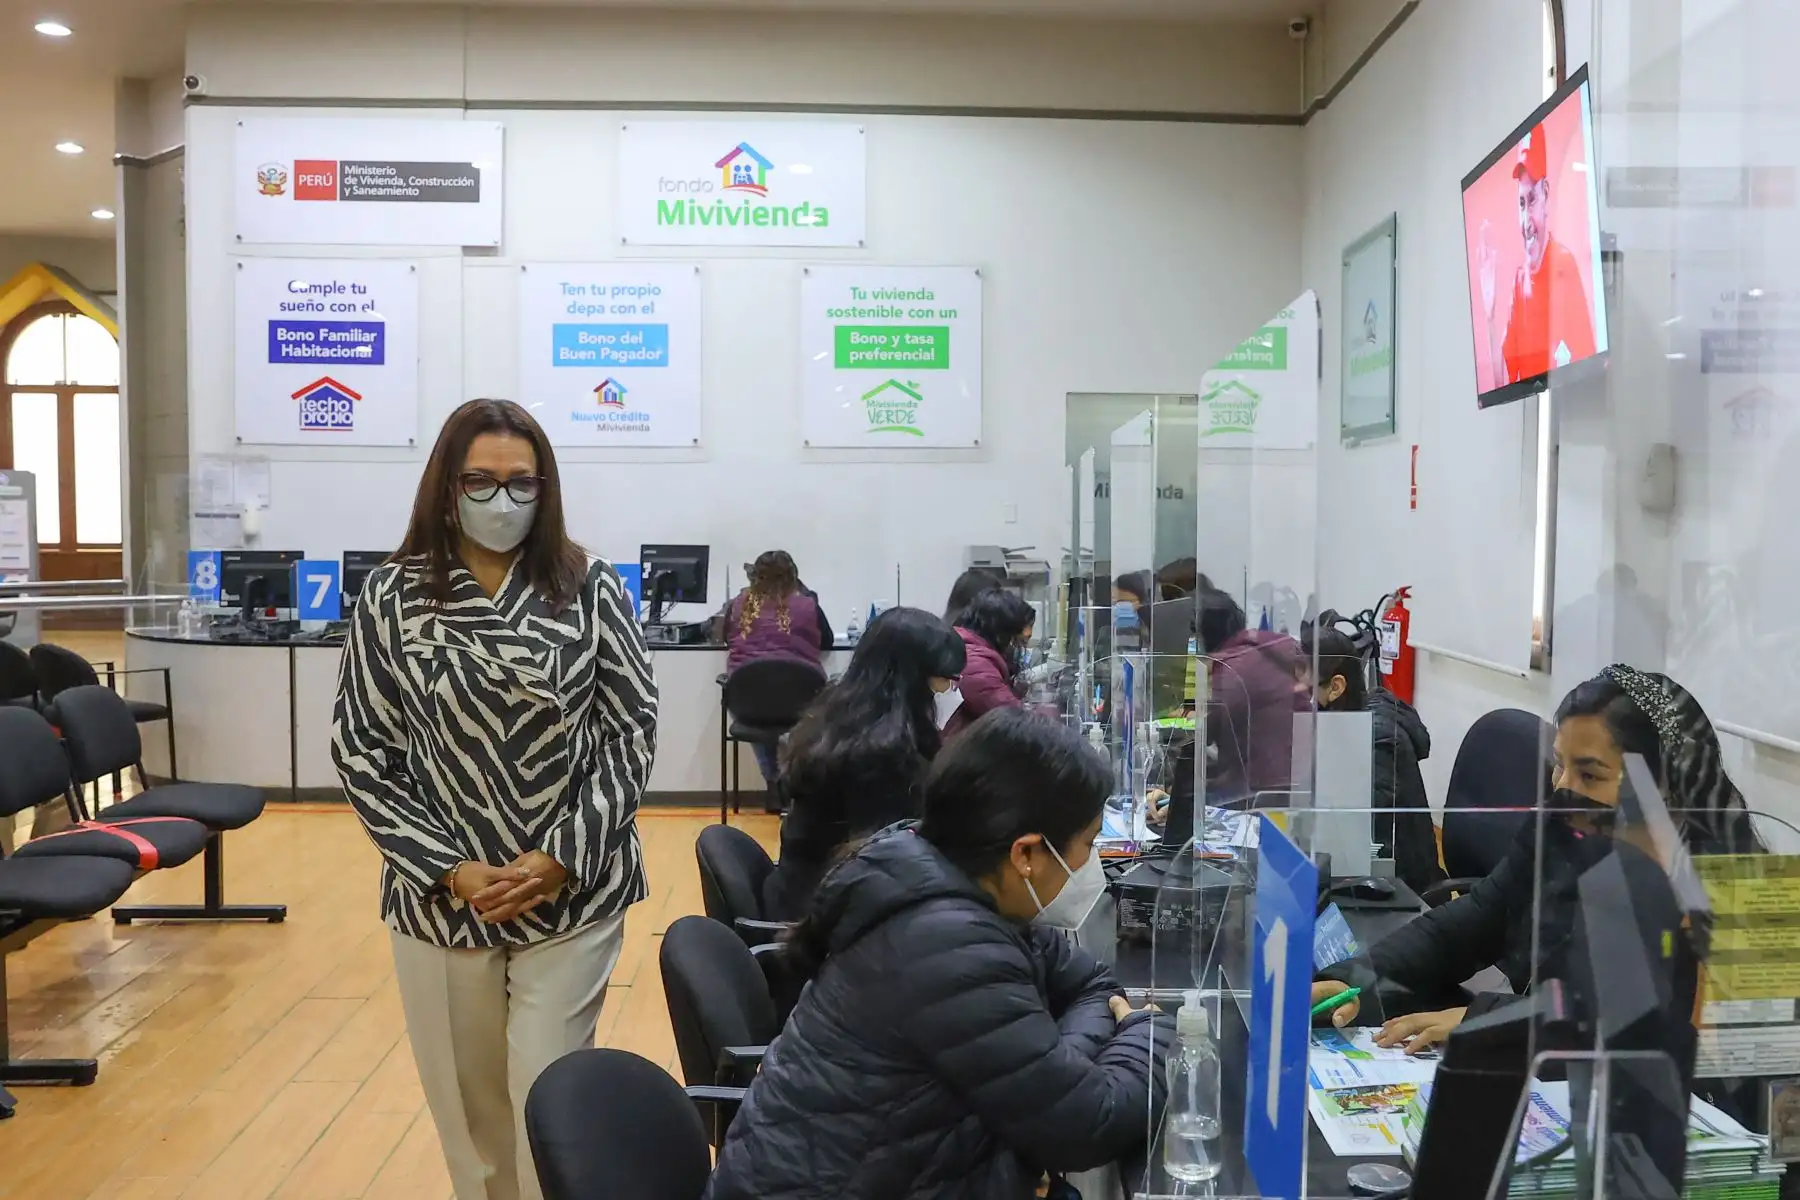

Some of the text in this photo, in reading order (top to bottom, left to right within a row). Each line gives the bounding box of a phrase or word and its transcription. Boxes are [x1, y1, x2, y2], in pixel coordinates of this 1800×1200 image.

[344, 165, 396, 175] Ministerio
[298, 172, 333, 187] PERÚ
[344, 176, 475, 187] de Vivienda, Construcción
[658, 176, 714, 193] fondo
[344, 186, 420, 196] y Saneamiento
[657, 199, 829, 227] Mivivienda
[351, 282, 367, 294] tu
[559, 282, 662, 299] Ten tu propio
[850, 286, 935, 300] Tu vivienda
[279, 299, 375, 312] sueño con el
[566, 301, 655, 317] depa con el
[826, 305, 957, 318] sostenible con un
[277, 328, 378, 342] Bono Familiar
[578, 331, 643, 344] Bono del
[850, 331, 935, 347] Bono y tasa
[559, 347, 663, 363] Buen Pagador
[849, 347, 935, 364] preferencial
[300, 397, 350, 412] techo
[301, 412, 353, 428] propio
[571, 411, 606, 421] Nuevo
[867, 408, 916, 424] VERDE
[195, 560, 218, 590] 8
[306, 574, 333, 609] 7
[1263, 916, 1289, 1131] 1
